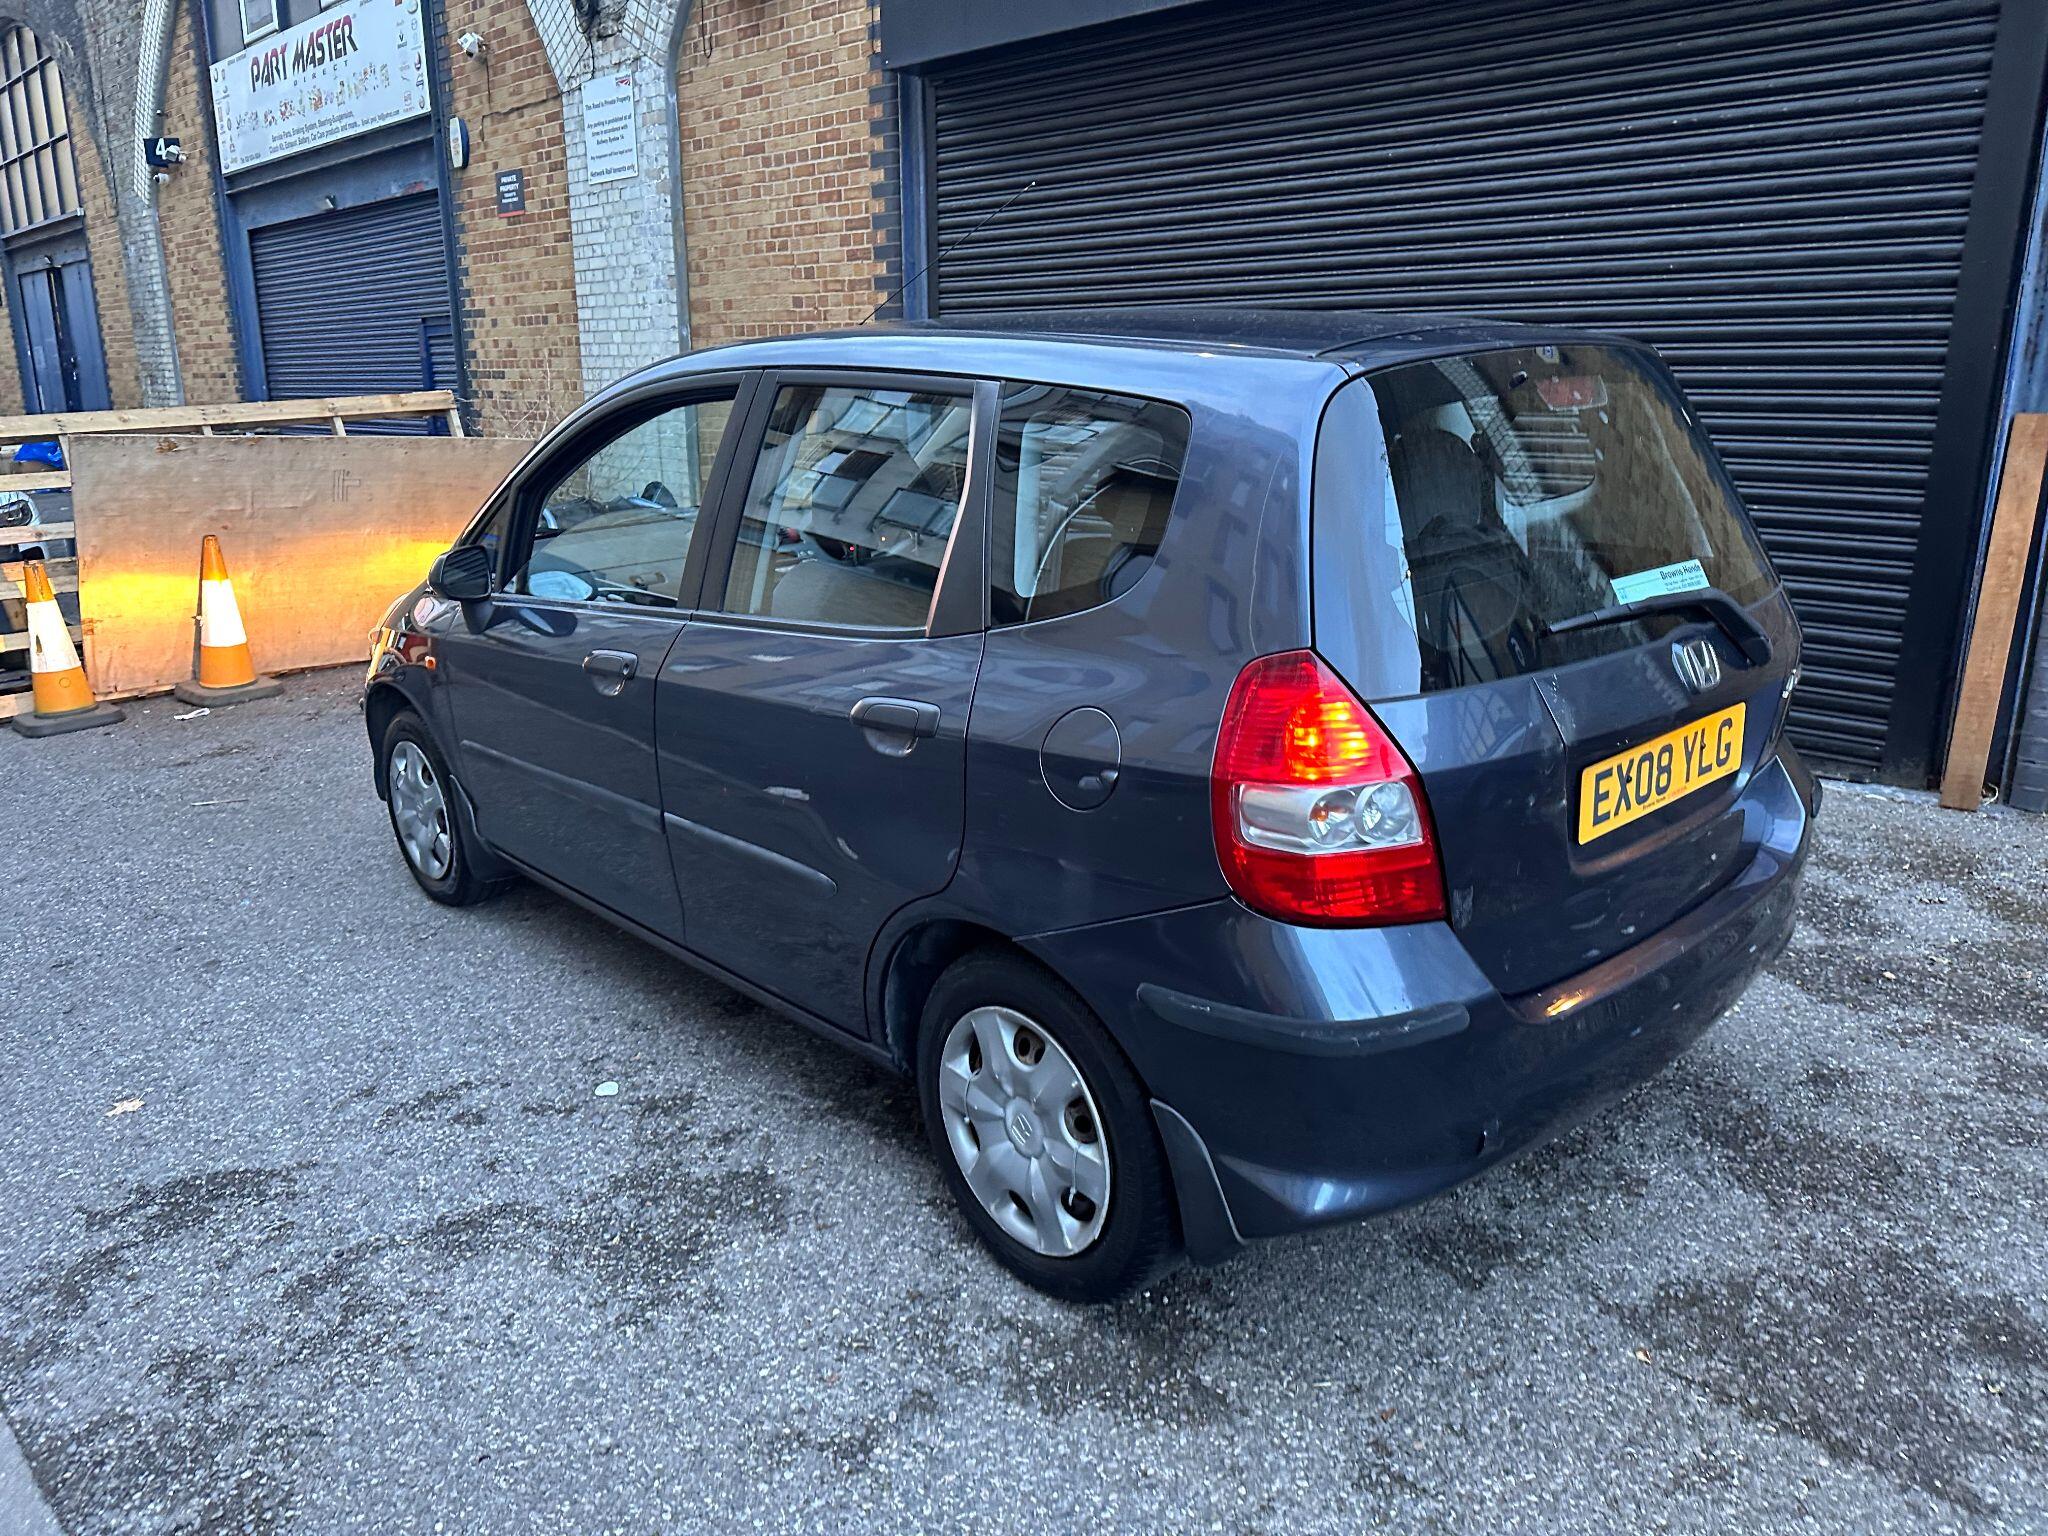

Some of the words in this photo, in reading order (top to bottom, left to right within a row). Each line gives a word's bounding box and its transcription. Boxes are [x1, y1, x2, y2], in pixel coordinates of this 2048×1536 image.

[251, 42, 289, 93] PART
[292, 15, 358, 76] MASTER
[294, 59, 348, 86] DIRECT
[155, 137, 167, 160] 4
[1593, 743, 1673, 827] EX08
[1683, 717, 1733, 784] YLG
